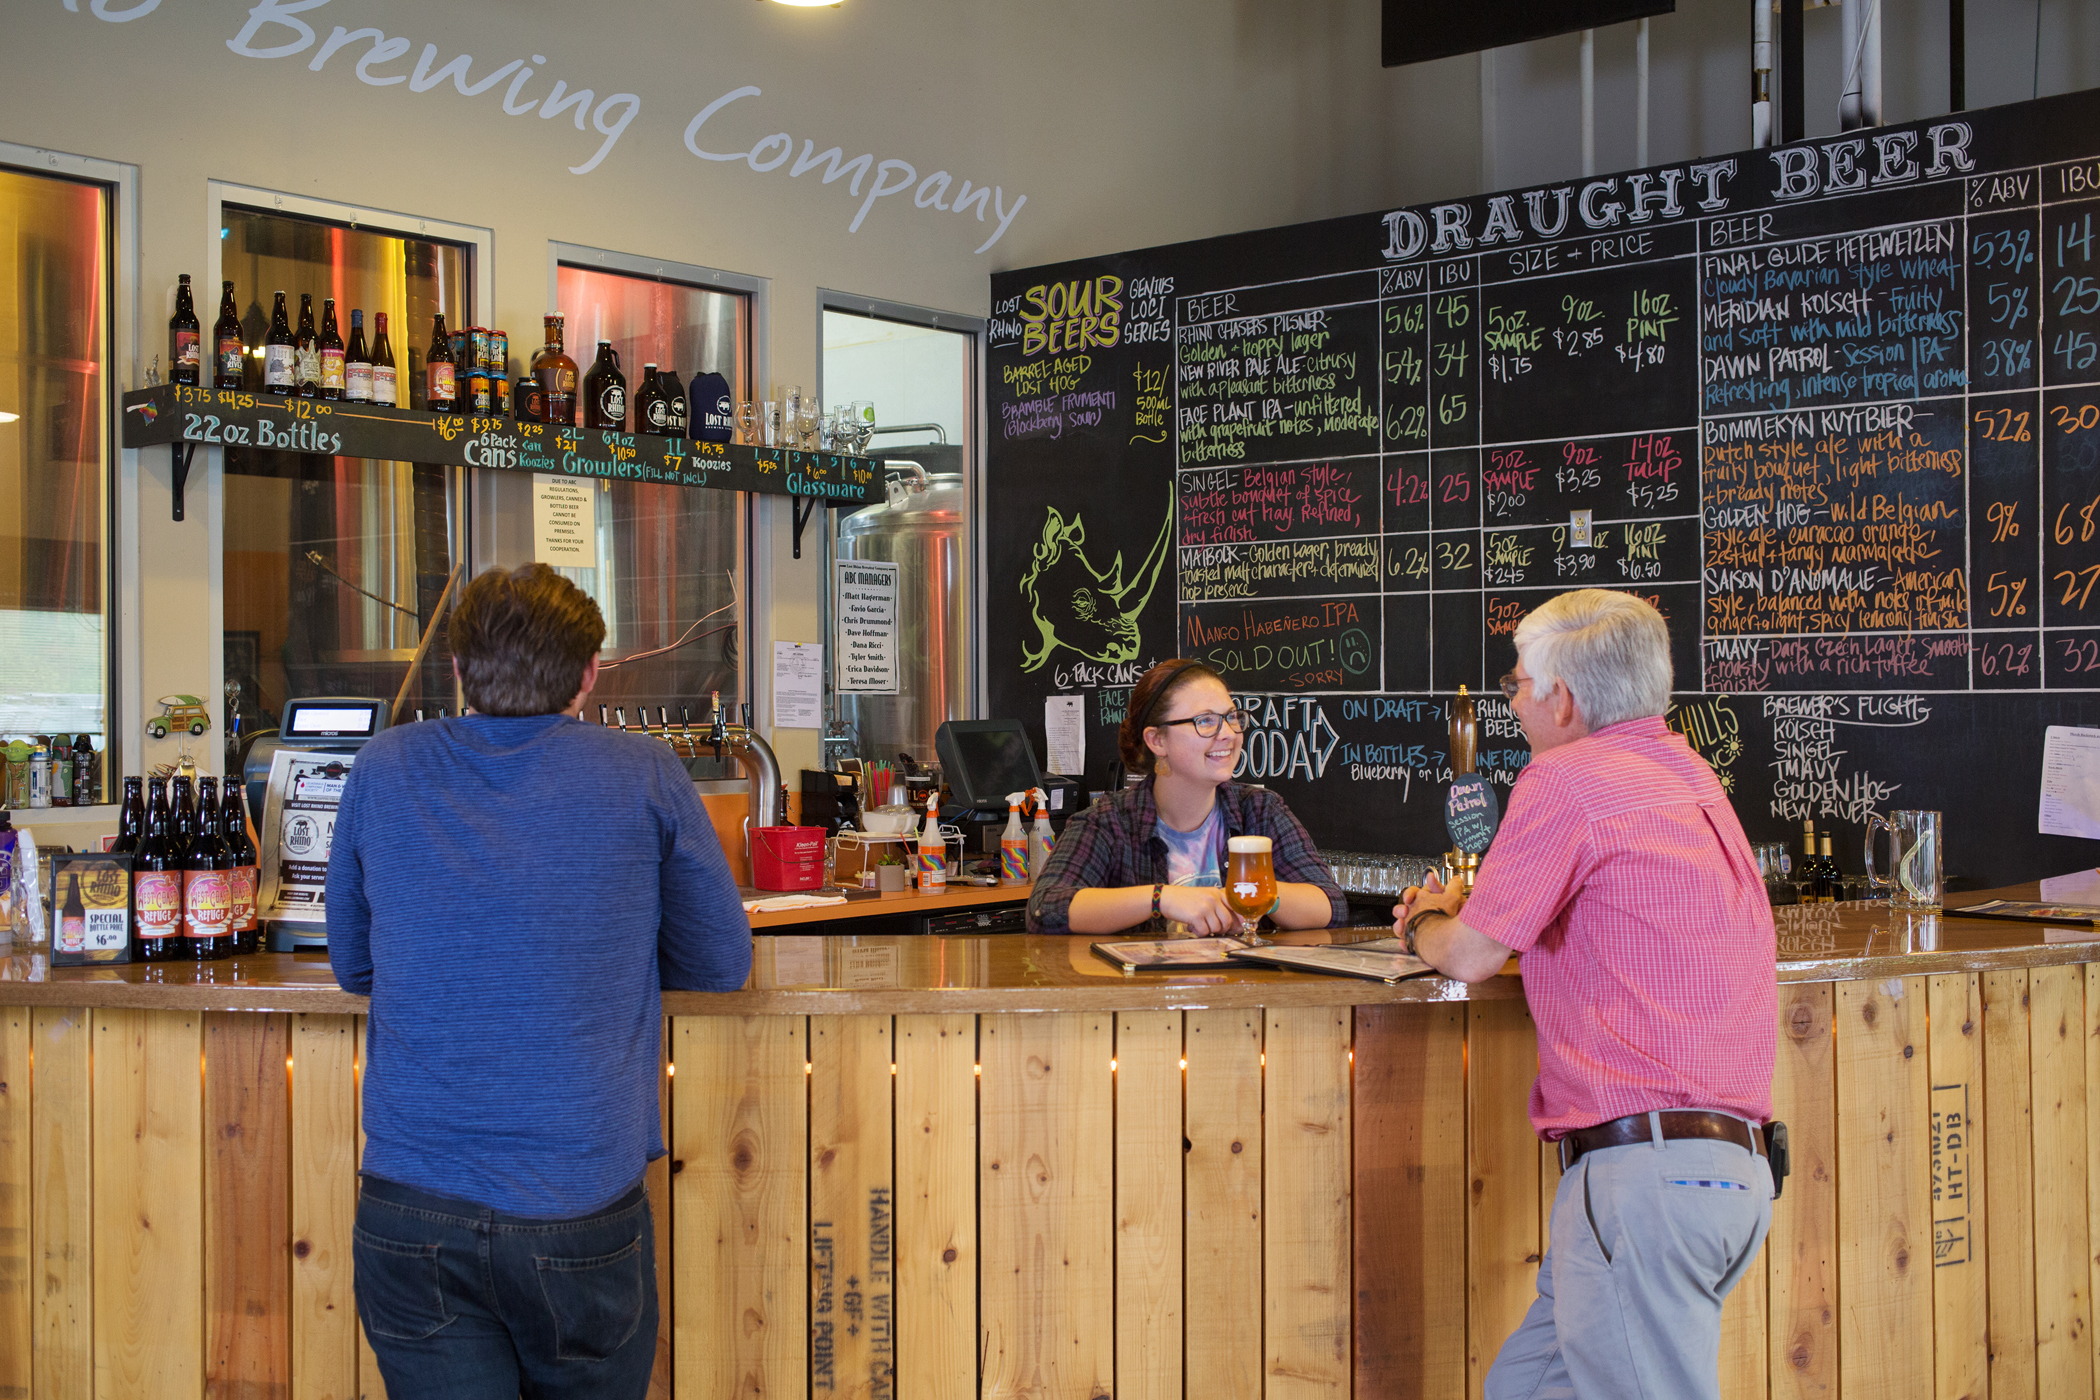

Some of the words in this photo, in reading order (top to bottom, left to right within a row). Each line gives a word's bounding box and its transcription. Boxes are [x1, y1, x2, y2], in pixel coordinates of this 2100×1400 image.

[226, 0, 642, 175] Brewing
[683, 84, 1027, 253] Company
[1381, 157, 1738, 260] DRAUGHT
[1770, 120, 1975, 202] BEER
[2061, 163, 2100, 193] IBU
[1710, 213, 1779, 247] BEER
[2057, 212, 2096, 268] 14
[1508, 246, 1560, 276] SIZE
[1591, 232, 1654, 263] PRICE
[1705, 251, 1765, 278] FINAL
[1768, 240, 1832, 268] GLIDE
[1381, 267, 1424, 295] %ABV
[1440, 260, 1471, 285] IBU
[1764, 265, 1840, 291] Bavarian
[1019, 275, 1124, 322] SOUR
[1129, 276, 1174, 299] GENIUS
[996, 295, 1022, 314] LOST
[1131, 297, 1166, 320] LOCI
[1188, 293, 1240, 323] BEER
[1436, 295, 1470, 329] 45
[1704, 294, 1790, 332] MERIDIAN
[1988, 282, 2029, 330] 5%
[989, 318, 1022, 343] RHINO
[1023, 312, 1121, 356] BEERS
[1124, 319, 1170, 344] SERIES
[1179, 324, 1213, 345] RHINO
[1218, 318, 1267, 339] CHASERS
[1627, 316, 1680, 343] PINT
[1243, 334, 1284, 357] hoppy
[1435, 339, 1469, 378] 34
[1614, 341, 1665, 373] $4.80
[2053, 329, 2097, 370] 45
[1180, 363, 1204, 382] NEW
[1207, 358, 1240, 380] RIVER
[1245, 355, 1271, 378] PALE
[1488, 354, 1533, 384] $1.75
[1704, 352, 1761, 384] DAWN
[1769, 342, 1833, 382] PATROL
[1017, 379, 1042, 397] LOST
[1050, 376, 1080, 394] HOG
[174, 384, 212, 407] $3.75
[217, 392, 254, 411] $4.25
[284, 399, 332, 420] $12.00
[1001, 394, 1058, 419] BRAMBLE
[1062, 391, 1116, 412] FRUMENTI
[1180, 404, 1208, 430] FACE
[1213, 401, 1257, 422] PLANT
[1439, 393, 1467, 425] 65
[471, 417, 502, 434] $9.75
[2050, 404, 2100, 434] 30
[182, 412, 222, 442] 22
[257, 418, 342, 455] Bottles
[464, 439, 518, 468] Cans
[519, 452, 555, 470] Koozies
[563, 451, 643, 478] Growlers
[663, 454, 682, 471] $7
[692, 455, 732, 472] Koozies
[665, 469, 680, 483] NOT
[1244, 464, 1295, 489] Belgian
[1622, 456, 1683, 484] TULIP
[786, 472, 865, 499] Glassware
[1439, 472, 1471, 503] 25
[1704, 503, 1769, 528] GOLDEN
[1775, 499, 1811, 530] HOG
[1987, 501, 2019, 542] 9%
[1436, 542, 1473, 571] 32
[844, 572, 857, 584] ABC
[858, 572, 892, 586] MANAGERS
[1703, 567, 1763, 598] SAISON
[1987, 571, 2027, 618] 5%
[1321, 602, 1359, 628] IPA
[1208, 645, 1273, 675] SOLD
[1098, 690, 1125, 707] FACE
[1342, 700, 1368, 721] ON
[1373, 700, 1428, 722] DRAFT
[1485, 719, 1528, 741] BEER
[1364, 744, 1430, 768] BOTTLES
[1773, 740, 1848, 760] SINGEL
[1351, 763, 1411, 803] Blueberry
[1768, 757, 1840, 781] TMAVY
[1773, 778, 1849, 802] GOLDEN
[1854, 770, 1902, 801] HOG
[1448, 792, 1487, 817] Patrol
[1770, 798, 1813, 821] NEW
[1819, 799, 1886, 824] RIVER
[290, 836, 311, 846] RHINO
[293, 827, 309, 836] LOST
[138, 893, 155, 909] WEST
[90, 914, 124, 923] SPECIAL
[90, 924, 108, 932] BOTTLE
[110, 924, 124, 932] PRICE
[144, 909, 171, 922] REFUGE
[197, 909, 225, 922] REFUGE
[1946, 1112, 1963, 1200] HT-DB
[870, 1188, 890, 1284] HANDLE
[871, 1294, 890, 1353] WITH
[814, 1321, 834, 1391] POINT
